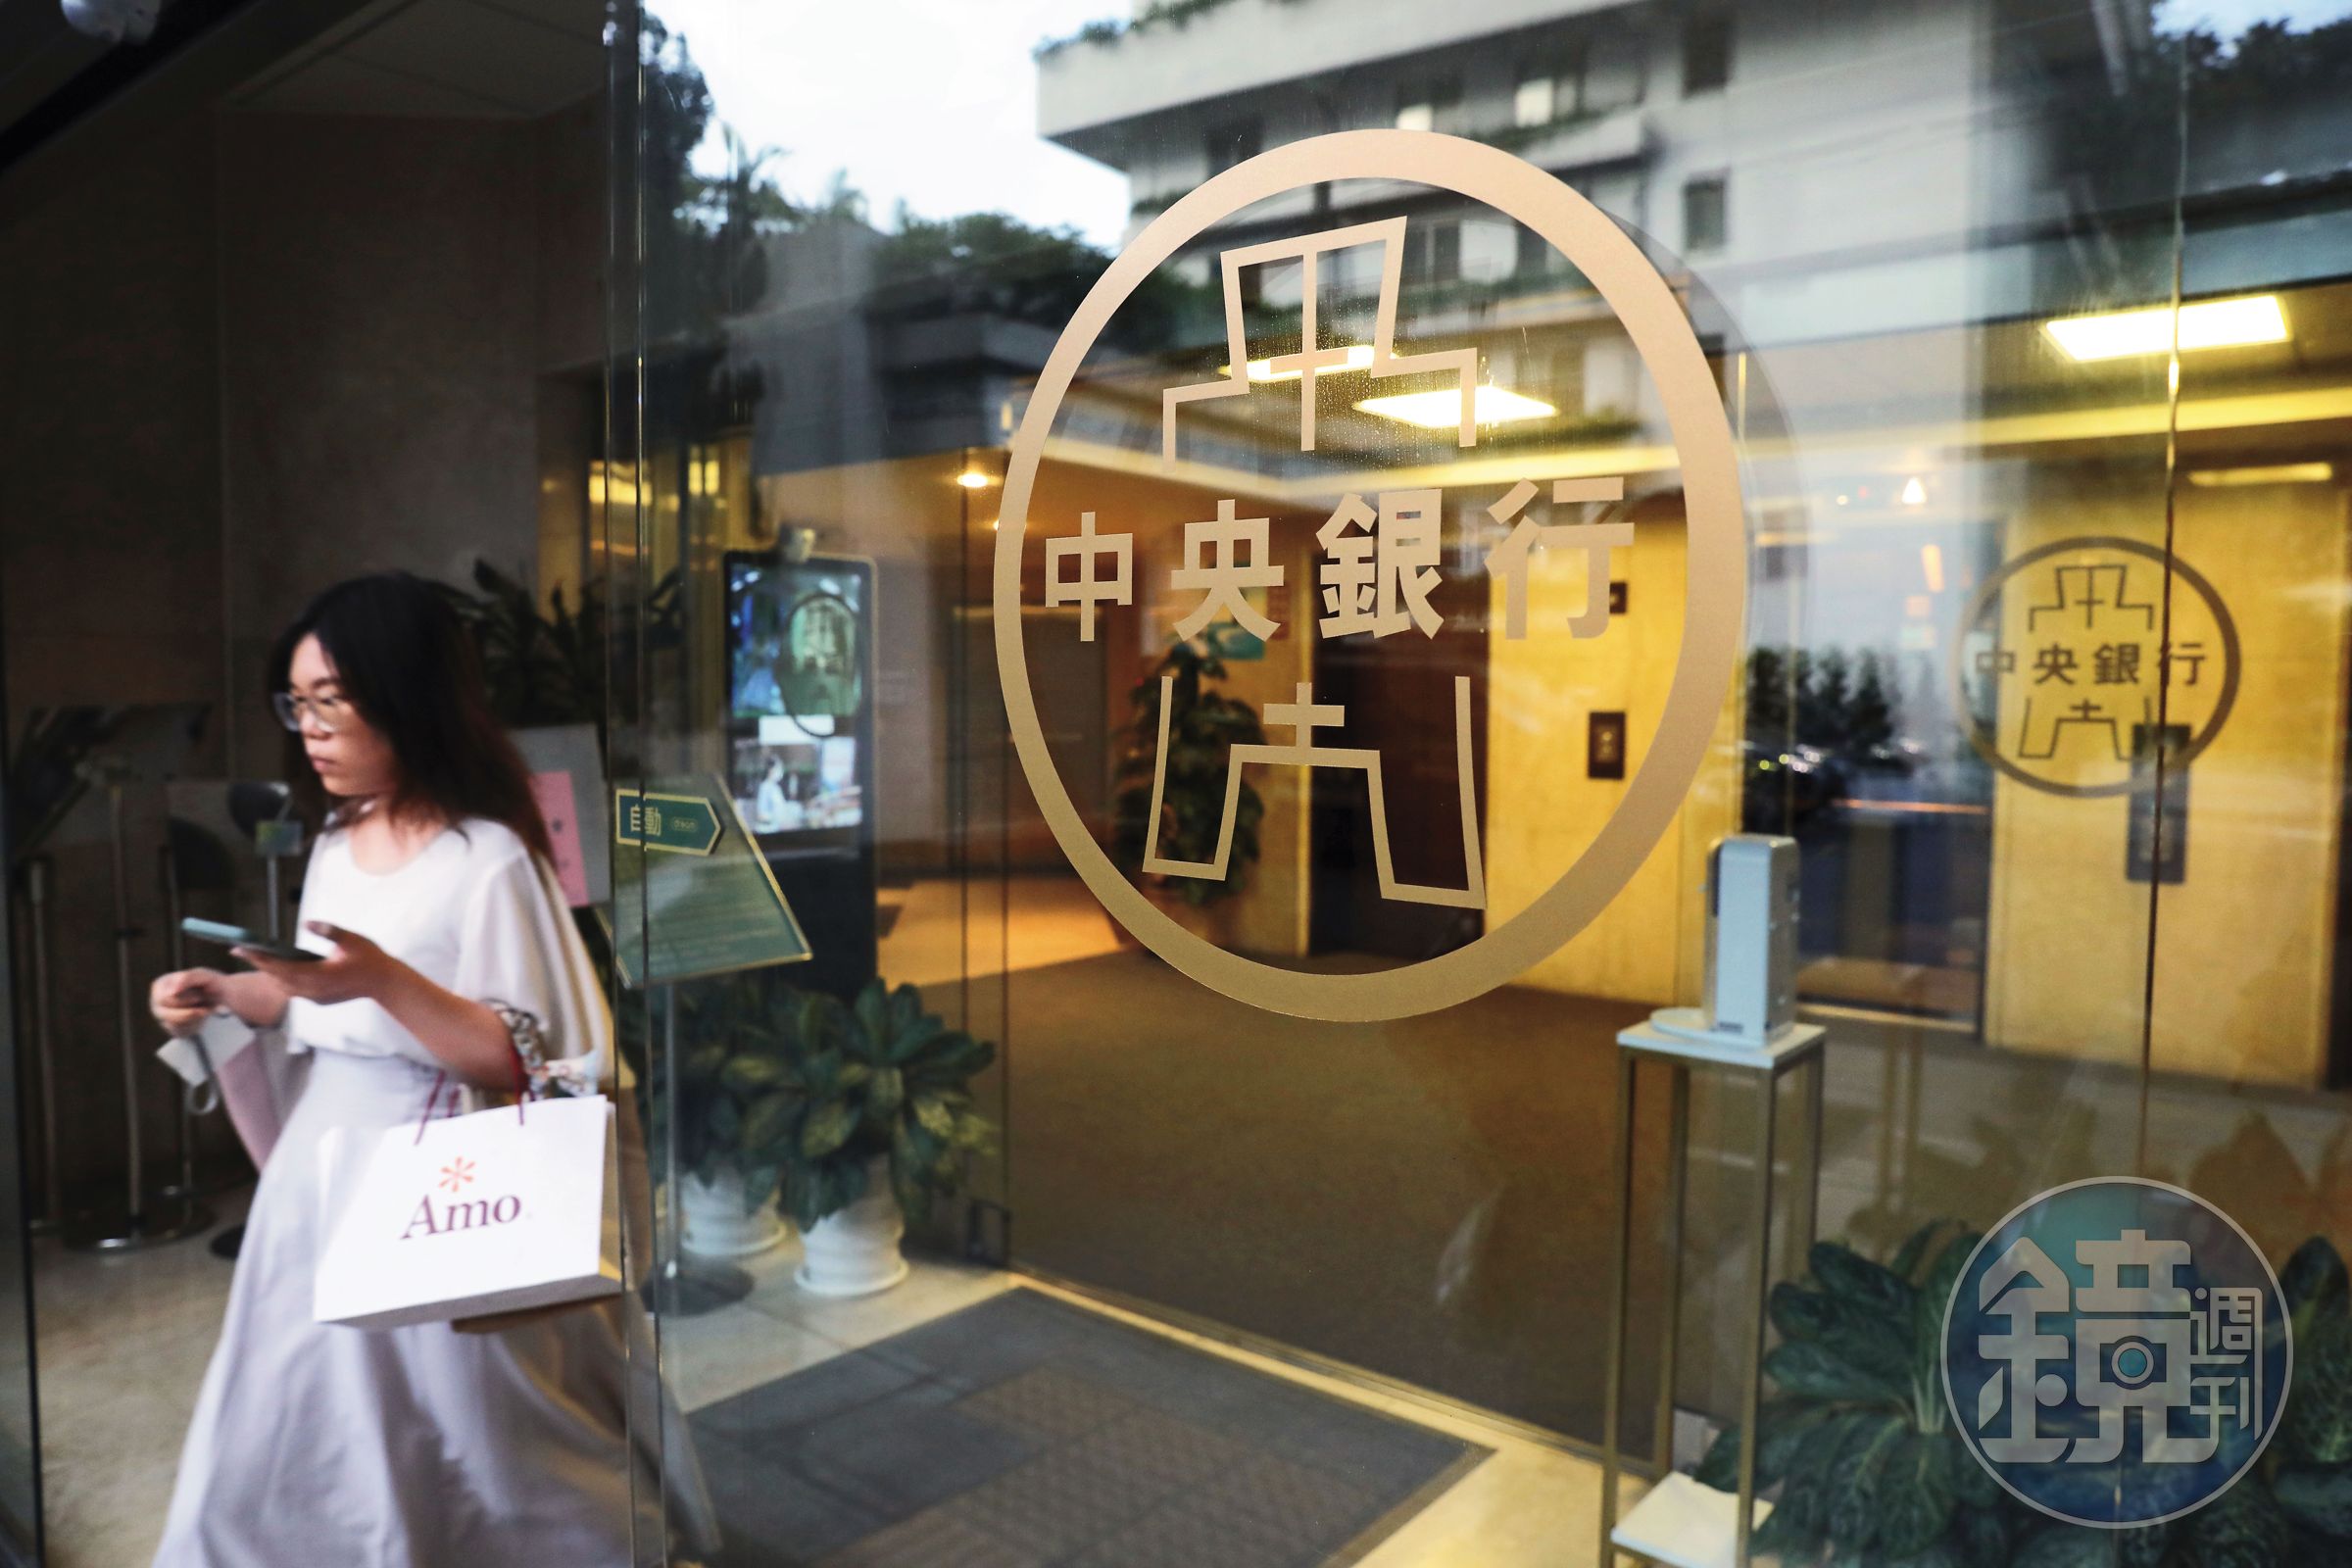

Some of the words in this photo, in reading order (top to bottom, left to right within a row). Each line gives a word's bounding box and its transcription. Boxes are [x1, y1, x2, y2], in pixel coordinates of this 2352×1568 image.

[1045, 476, 1635, 642] 中央銀行
[1975, 643, 2206, 686] 中央銀行
[400, 1194, 521, 1241] Amo
